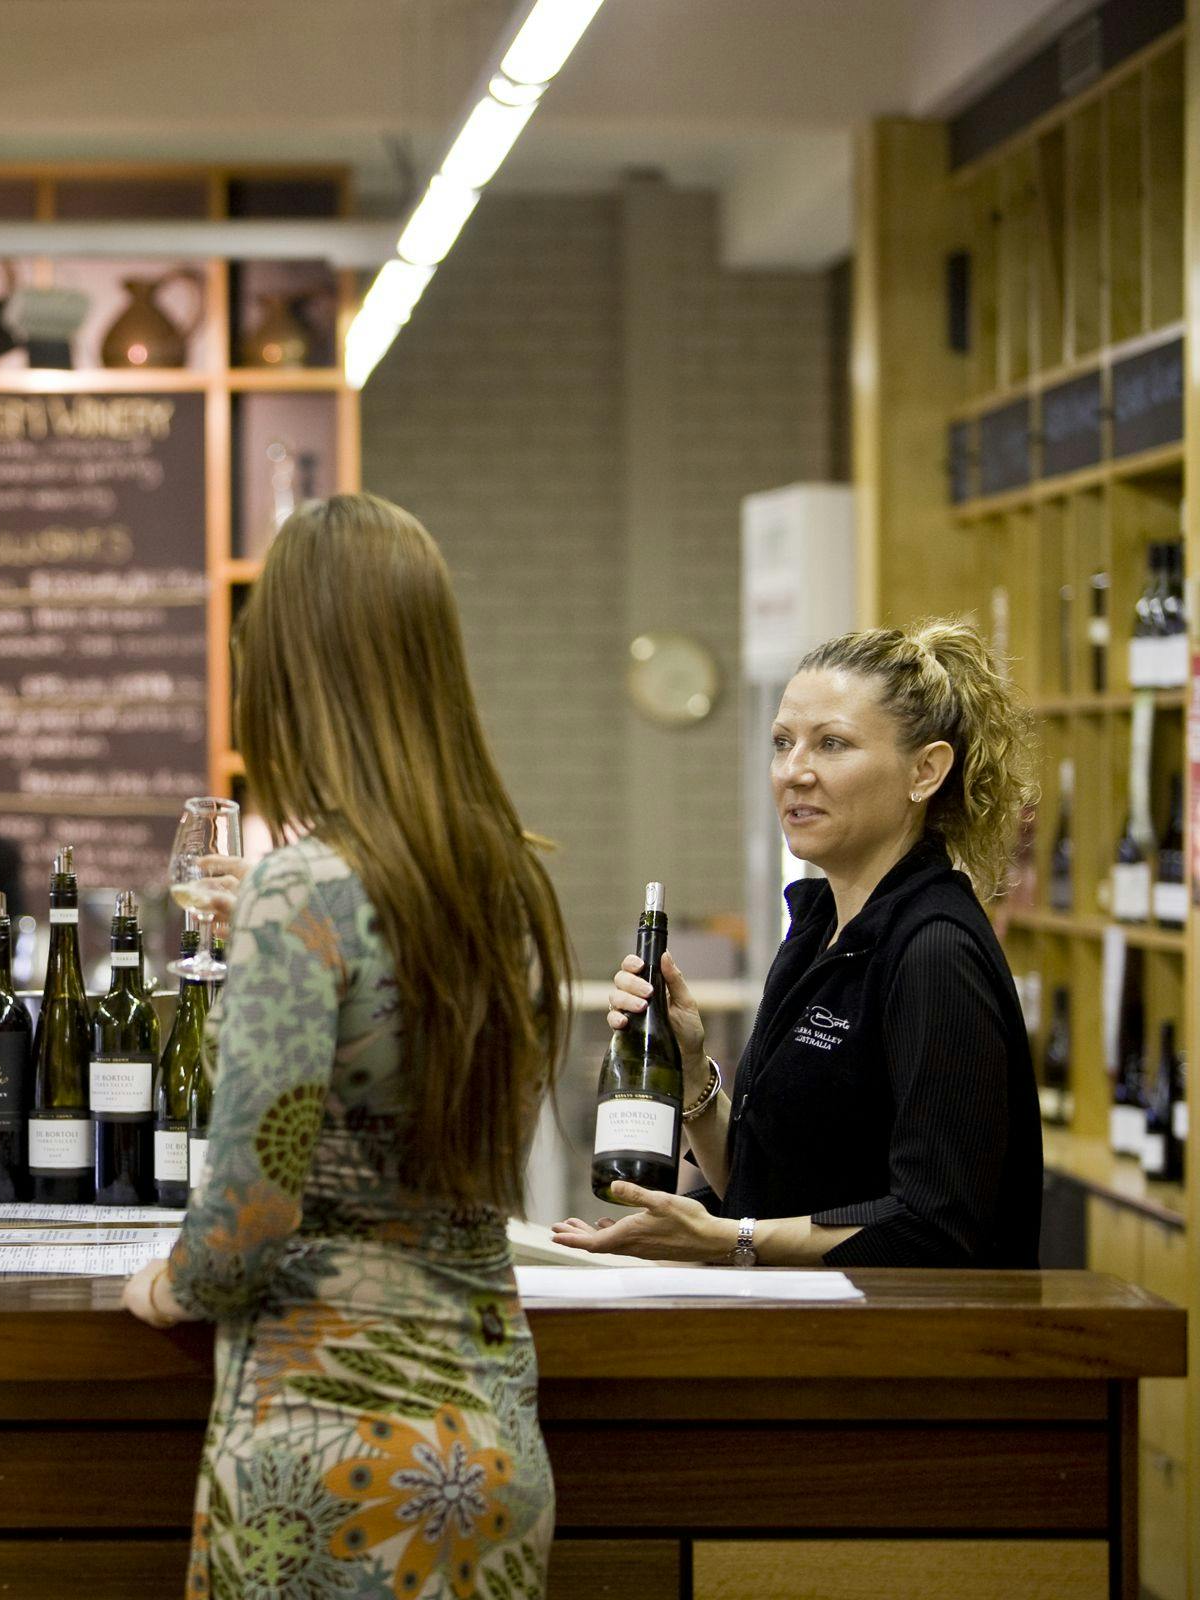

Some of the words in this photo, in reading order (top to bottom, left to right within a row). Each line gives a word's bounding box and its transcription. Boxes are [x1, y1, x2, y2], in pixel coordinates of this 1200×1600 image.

[814, 1030, 843, 1045] VALLEY
[102, 1074, 135, 1082] BORTOLI
[620, 1111, 657, 1121] BORTOLI
[45, 1130, 80, 1138] BORTOLI
